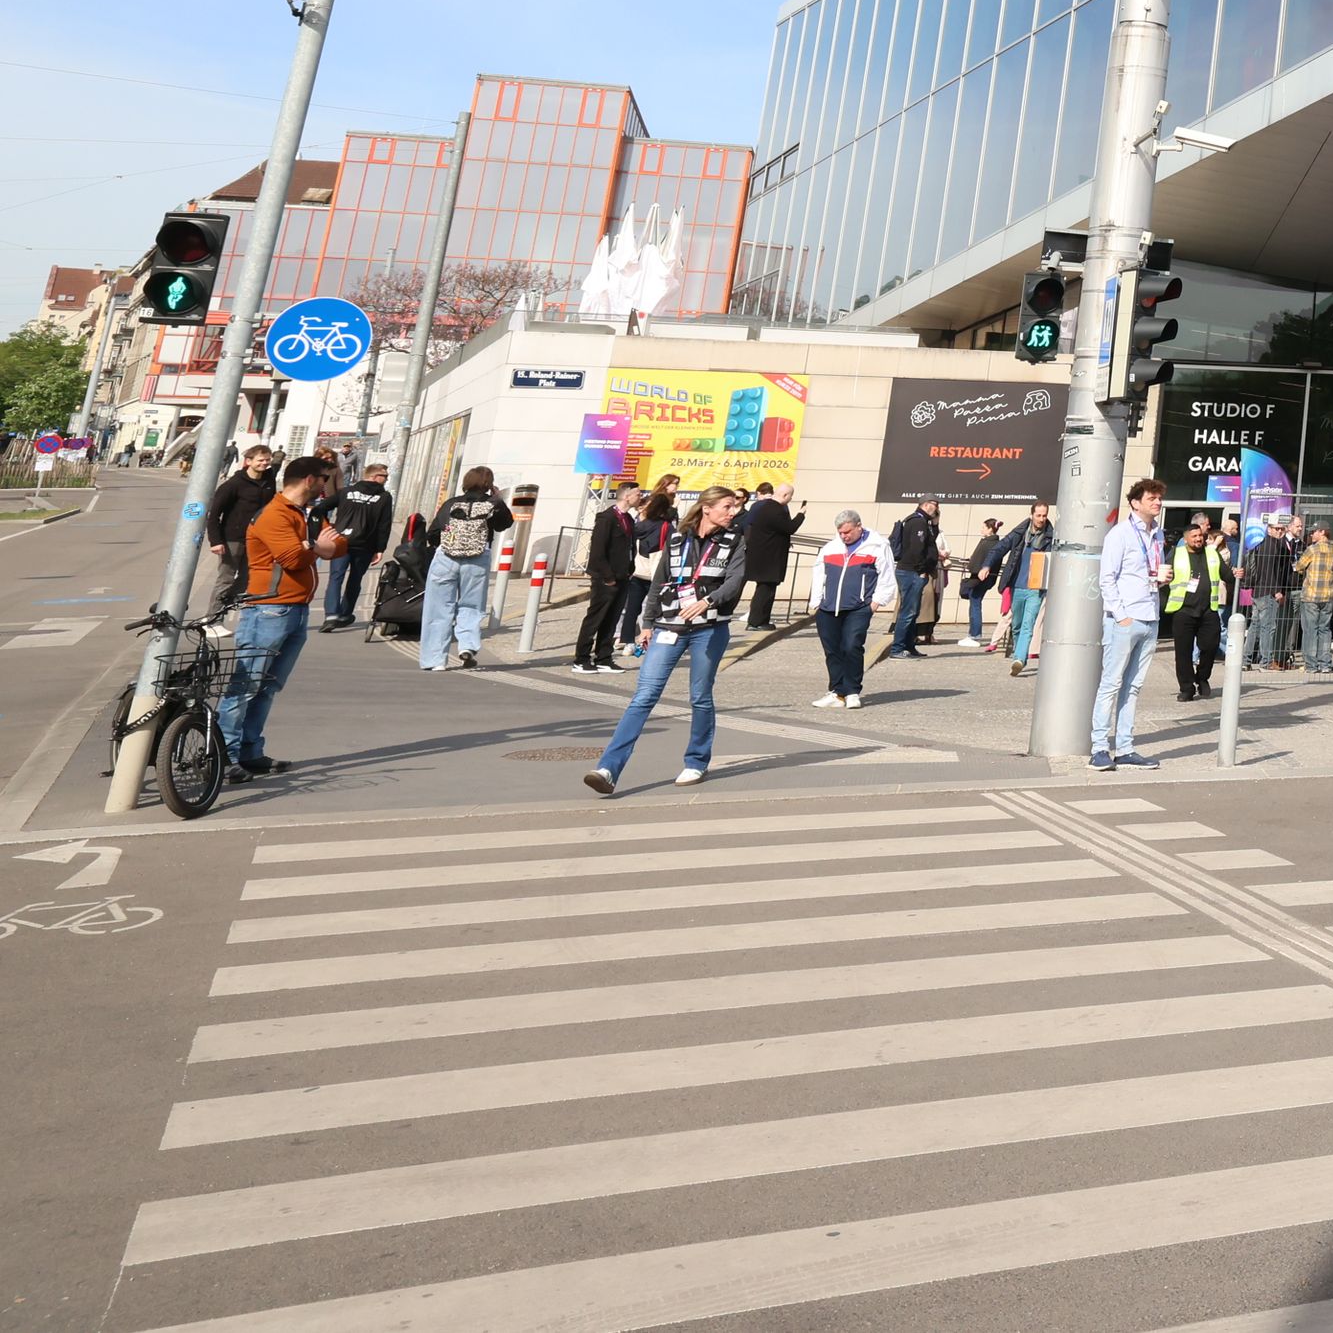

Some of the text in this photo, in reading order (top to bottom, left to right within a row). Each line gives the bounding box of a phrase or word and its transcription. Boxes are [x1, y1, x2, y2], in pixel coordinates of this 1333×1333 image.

[529, 371, 580, 380] Roland-Rainer-
[538, 379, 556, 387] Platz
[610, 377, 713, 405] WORLD OF
[607, 397, 715, 424] BRICKS
[1191, 401, 1276, 418] STUDIO F
[1193, 429, 1265, 446] HALLE F
[929, 446, 1023, 459] RESTAURANT
[670, 457, 789, 470] 28.März 6.April 2026
[1188, 456, 1242, 473] GARA
